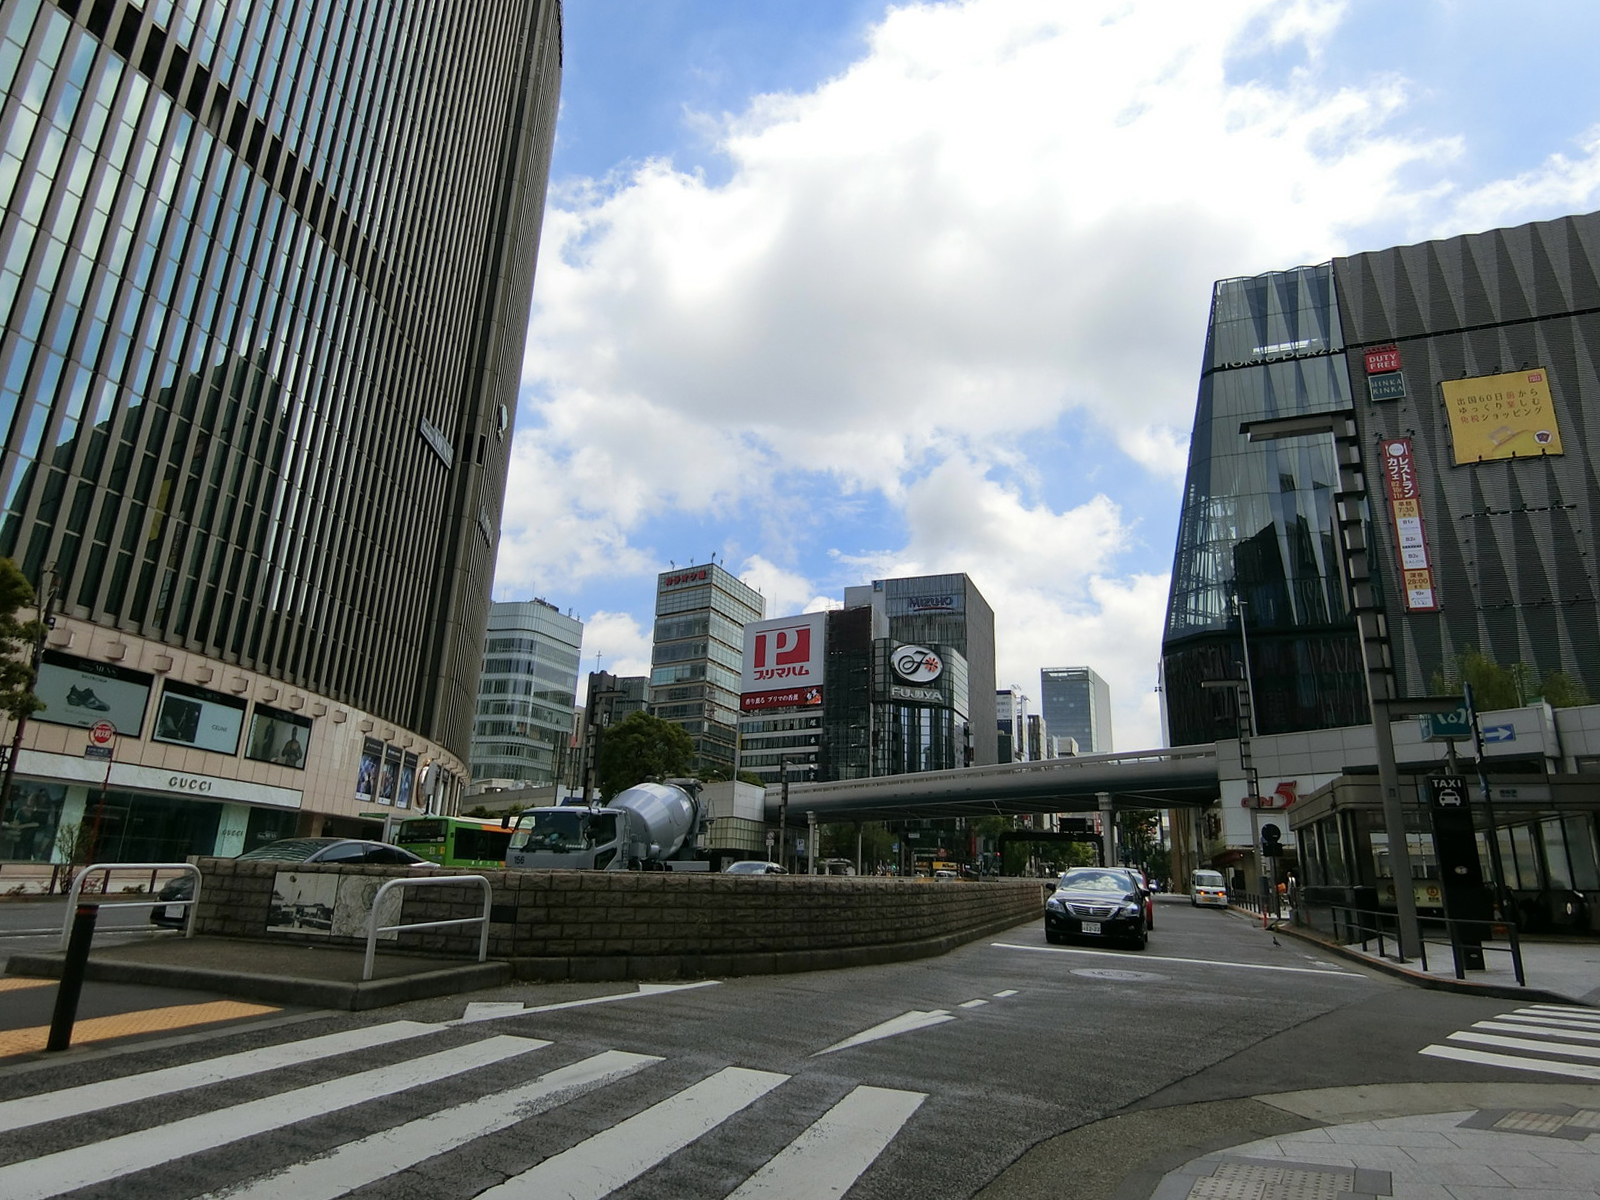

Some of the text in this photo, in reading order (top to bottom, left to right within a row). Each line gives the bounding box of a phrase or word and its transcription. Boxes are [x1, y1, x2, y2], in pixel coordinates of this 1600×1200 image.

[1223, 347, 1339, 369] TOKYU PLAZA
[1369, 353, 1396, 363] DUTY
[1370, 360, 1397, 370] FREE
[1387, 457, 1400, 480] カフェ
[1399, 457, 1414, 498] レストラン
[754, 666, 810, 680] プリマハム
[891, 687, 943, 700] FUJIYA
[168, 776, 212, 791] GUCCI
[1432, 779, 1461, 788] TAXI
[222, 829, 243, 837] GUCCI
[514, 855, 525, 865] 156
